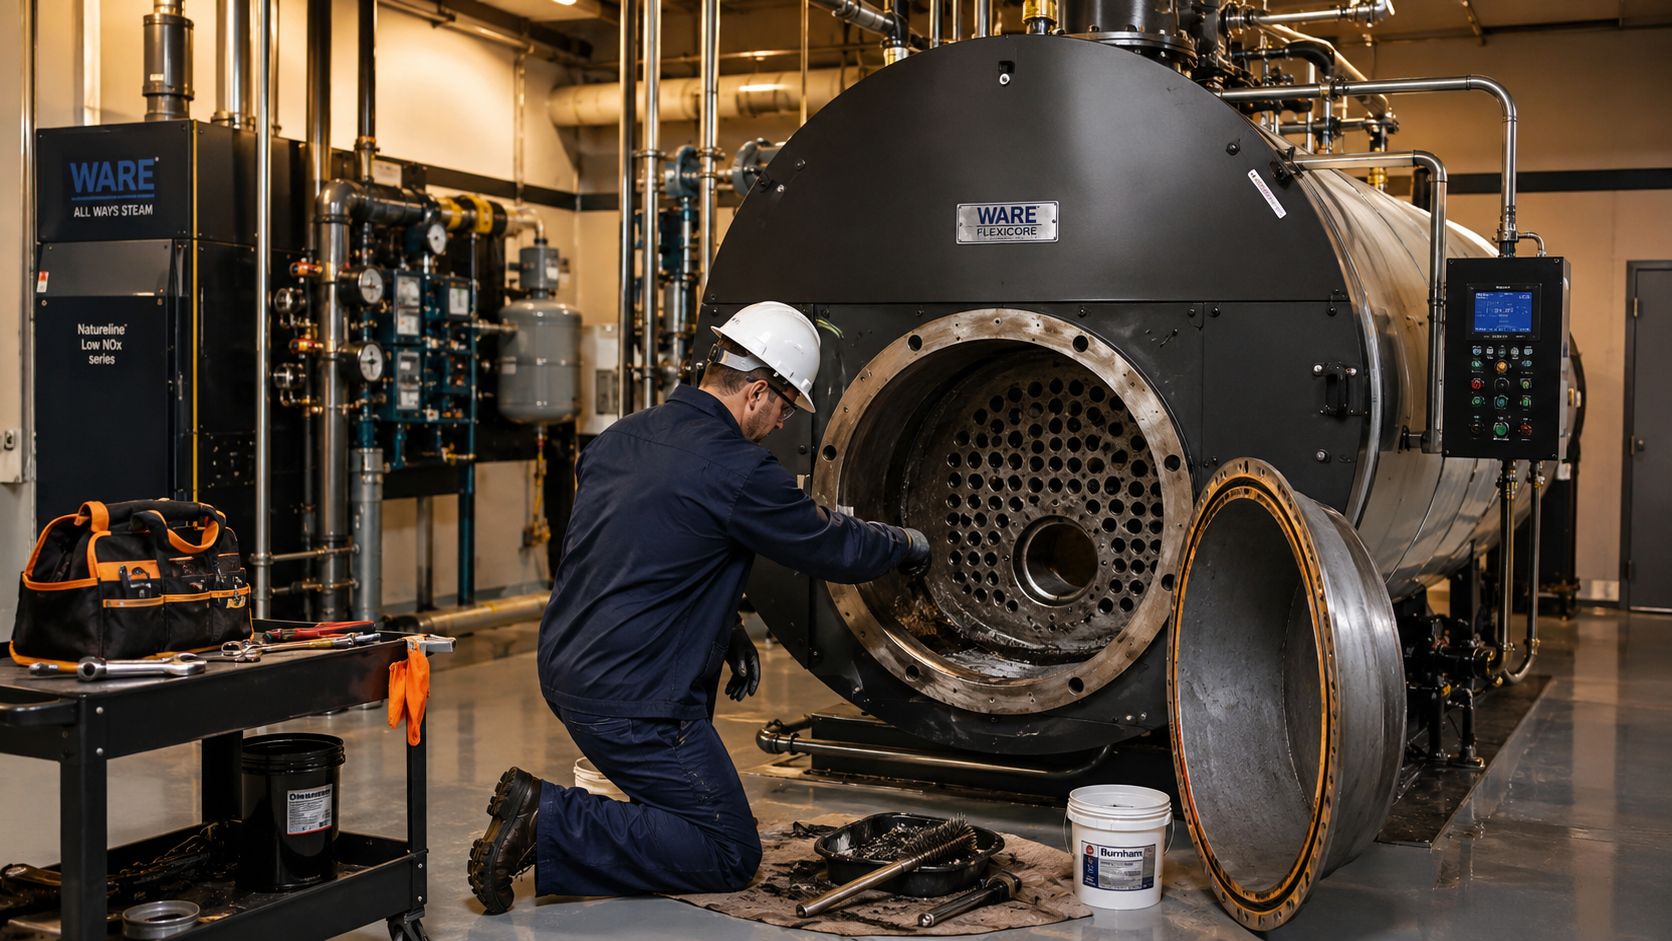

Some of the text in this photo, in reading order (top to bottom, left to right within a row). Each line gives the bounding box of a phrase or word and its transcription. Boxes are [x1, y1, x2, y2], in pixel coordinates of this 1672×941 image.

[69, 159, 155, 193] WARE
[73, 204, 153, 217] ALL WAYS STEAM
[976, 206, 1037, 224] WARE
[976, 227, 1037, 236] FLEXICORE
[77, 323, 126, 335] Natureline
[81, 338, 122, 350] Low NOx
[88, 353, 116, 365] series
[1100, 848, 1143, 857] Burnham
